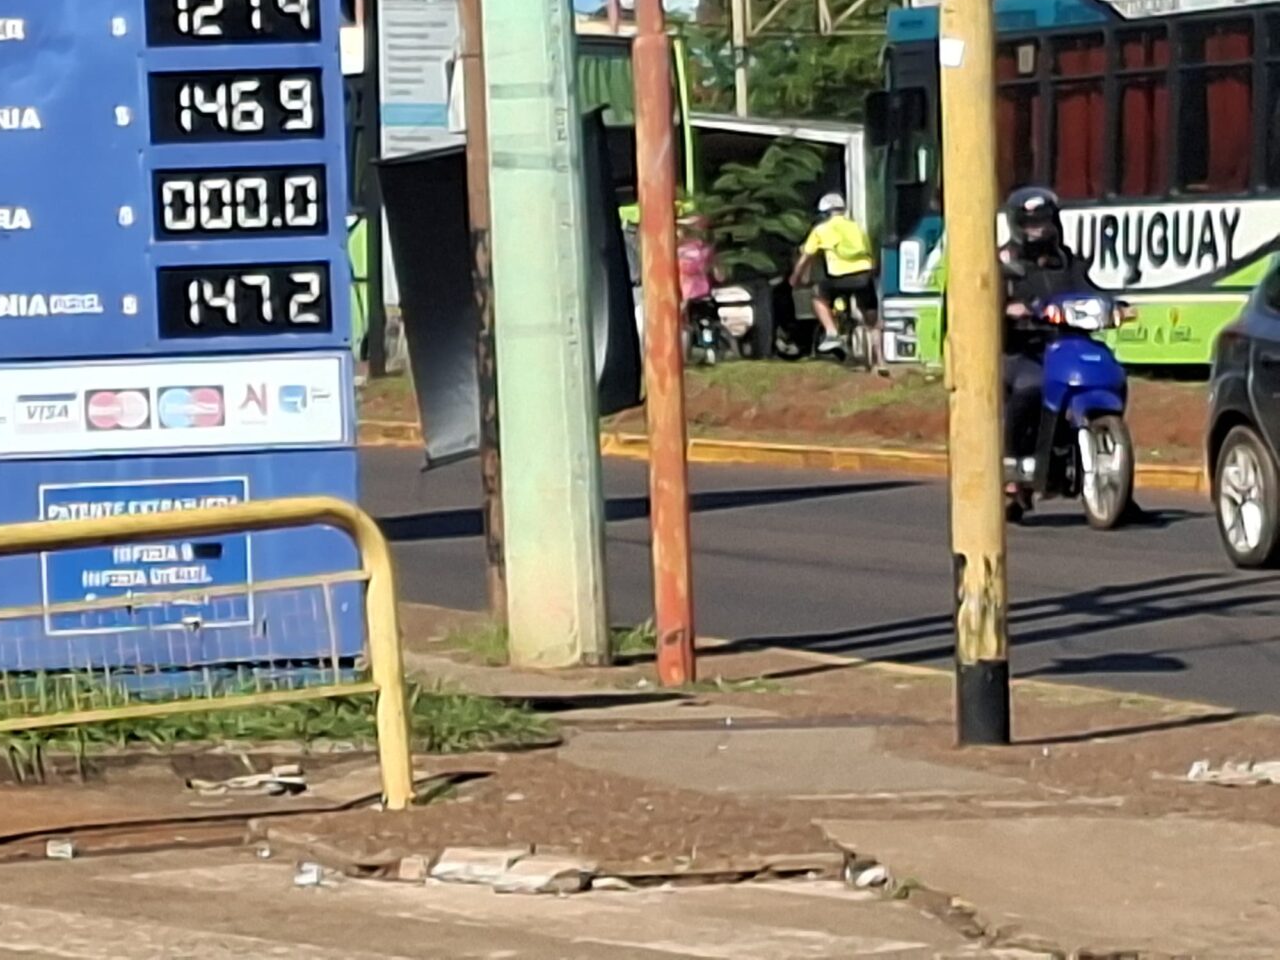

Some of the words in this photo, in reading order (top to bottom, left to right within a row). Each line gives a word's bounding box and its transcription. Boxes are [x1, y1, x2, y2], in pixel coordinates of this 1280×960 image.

[162, 174, 318, 230] 000.0
[1076, 206, 1242, 272] URUGUAY
[25, 404, 69, 421] VISA
